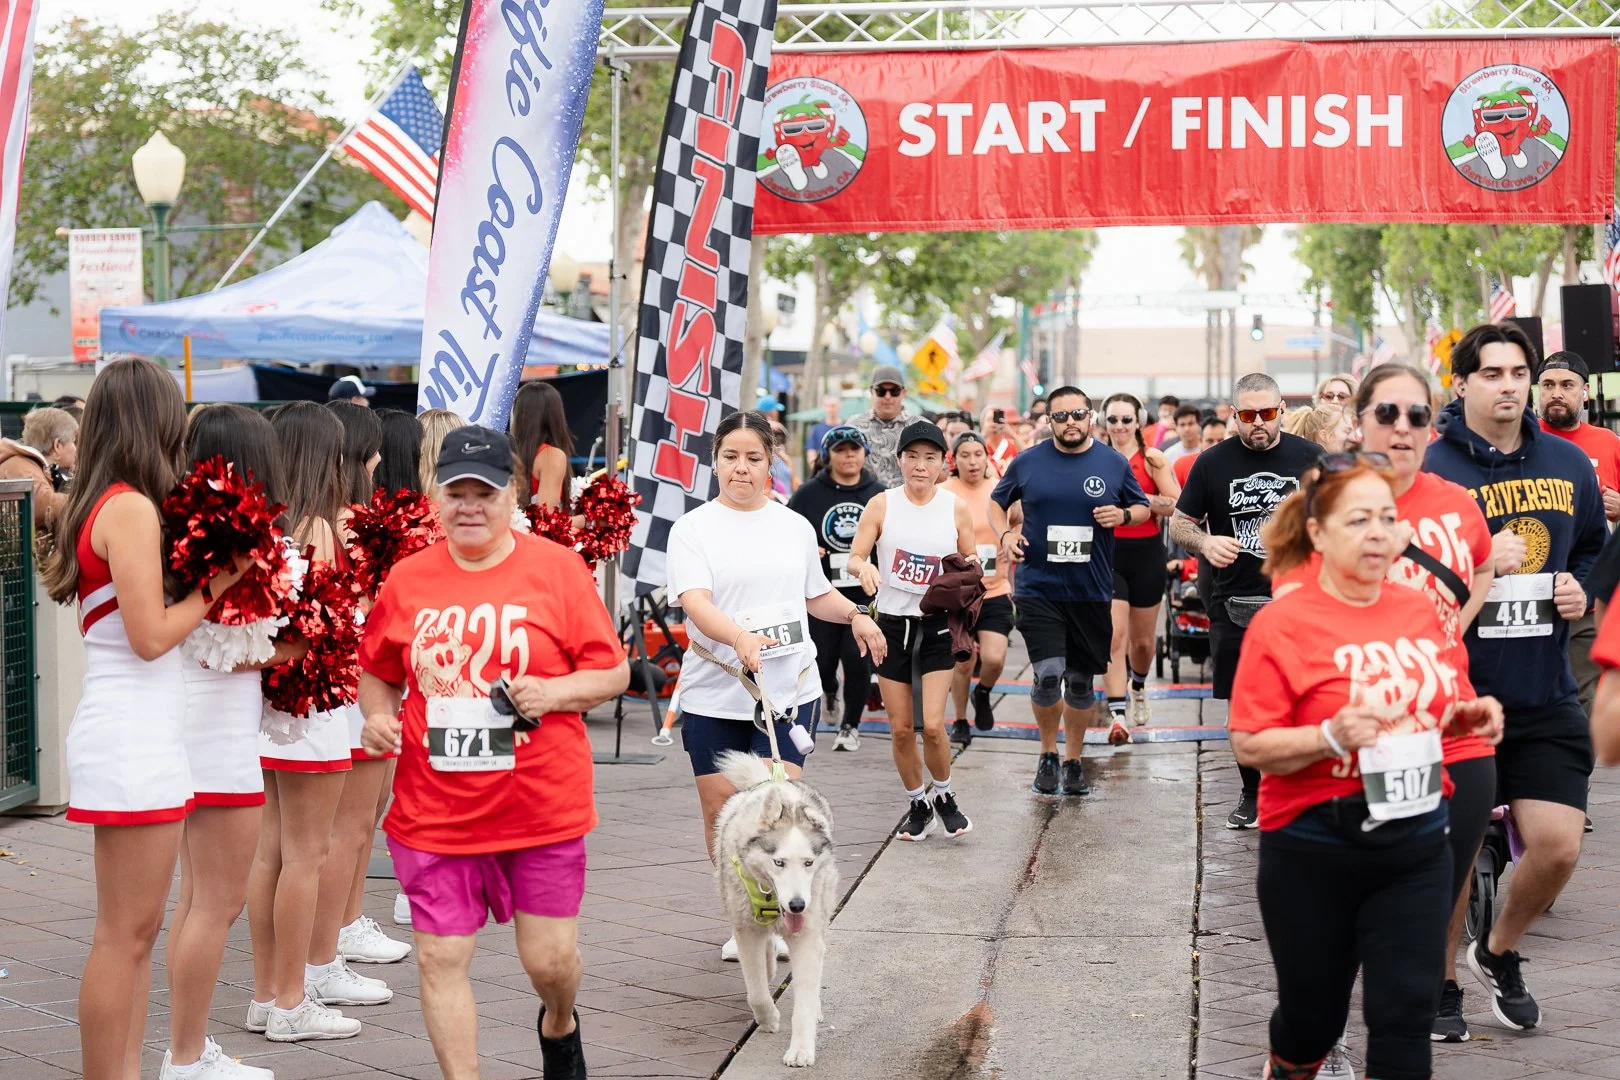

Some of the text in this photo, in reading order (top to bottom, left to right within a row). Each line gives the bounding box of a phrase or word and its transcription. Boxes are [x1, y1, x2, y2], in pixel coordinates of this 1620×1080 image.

[764, 81, 808, 107] trawberry
[810, 80, 838, 95] Stomp
[1458, 67, 1555, 95] Strawberry Stomp 5K
[898, 93, 1402, 157] START / FINISH
[1480, 145, 1499, 158] Walk
[1461, 163, 1499, 188] Garden
[1536, 160, 1553, 175] CA
[461, 136, 543, 341] Coast
[651, 19, 747, 494] FINISH
[1229, 492, 1260, 508] Don
[1479, 478, 1575, 519] RIVERSIDE
[1057, 541, 1082, 556] 621
[897, 560, 935, 584] 2357
[1496, 600, 1539, 626] 414
[411, 602, 530, 697] 2025
[444, 728, 494, 757] 671
[1384, 764, 1433, 803] 507
